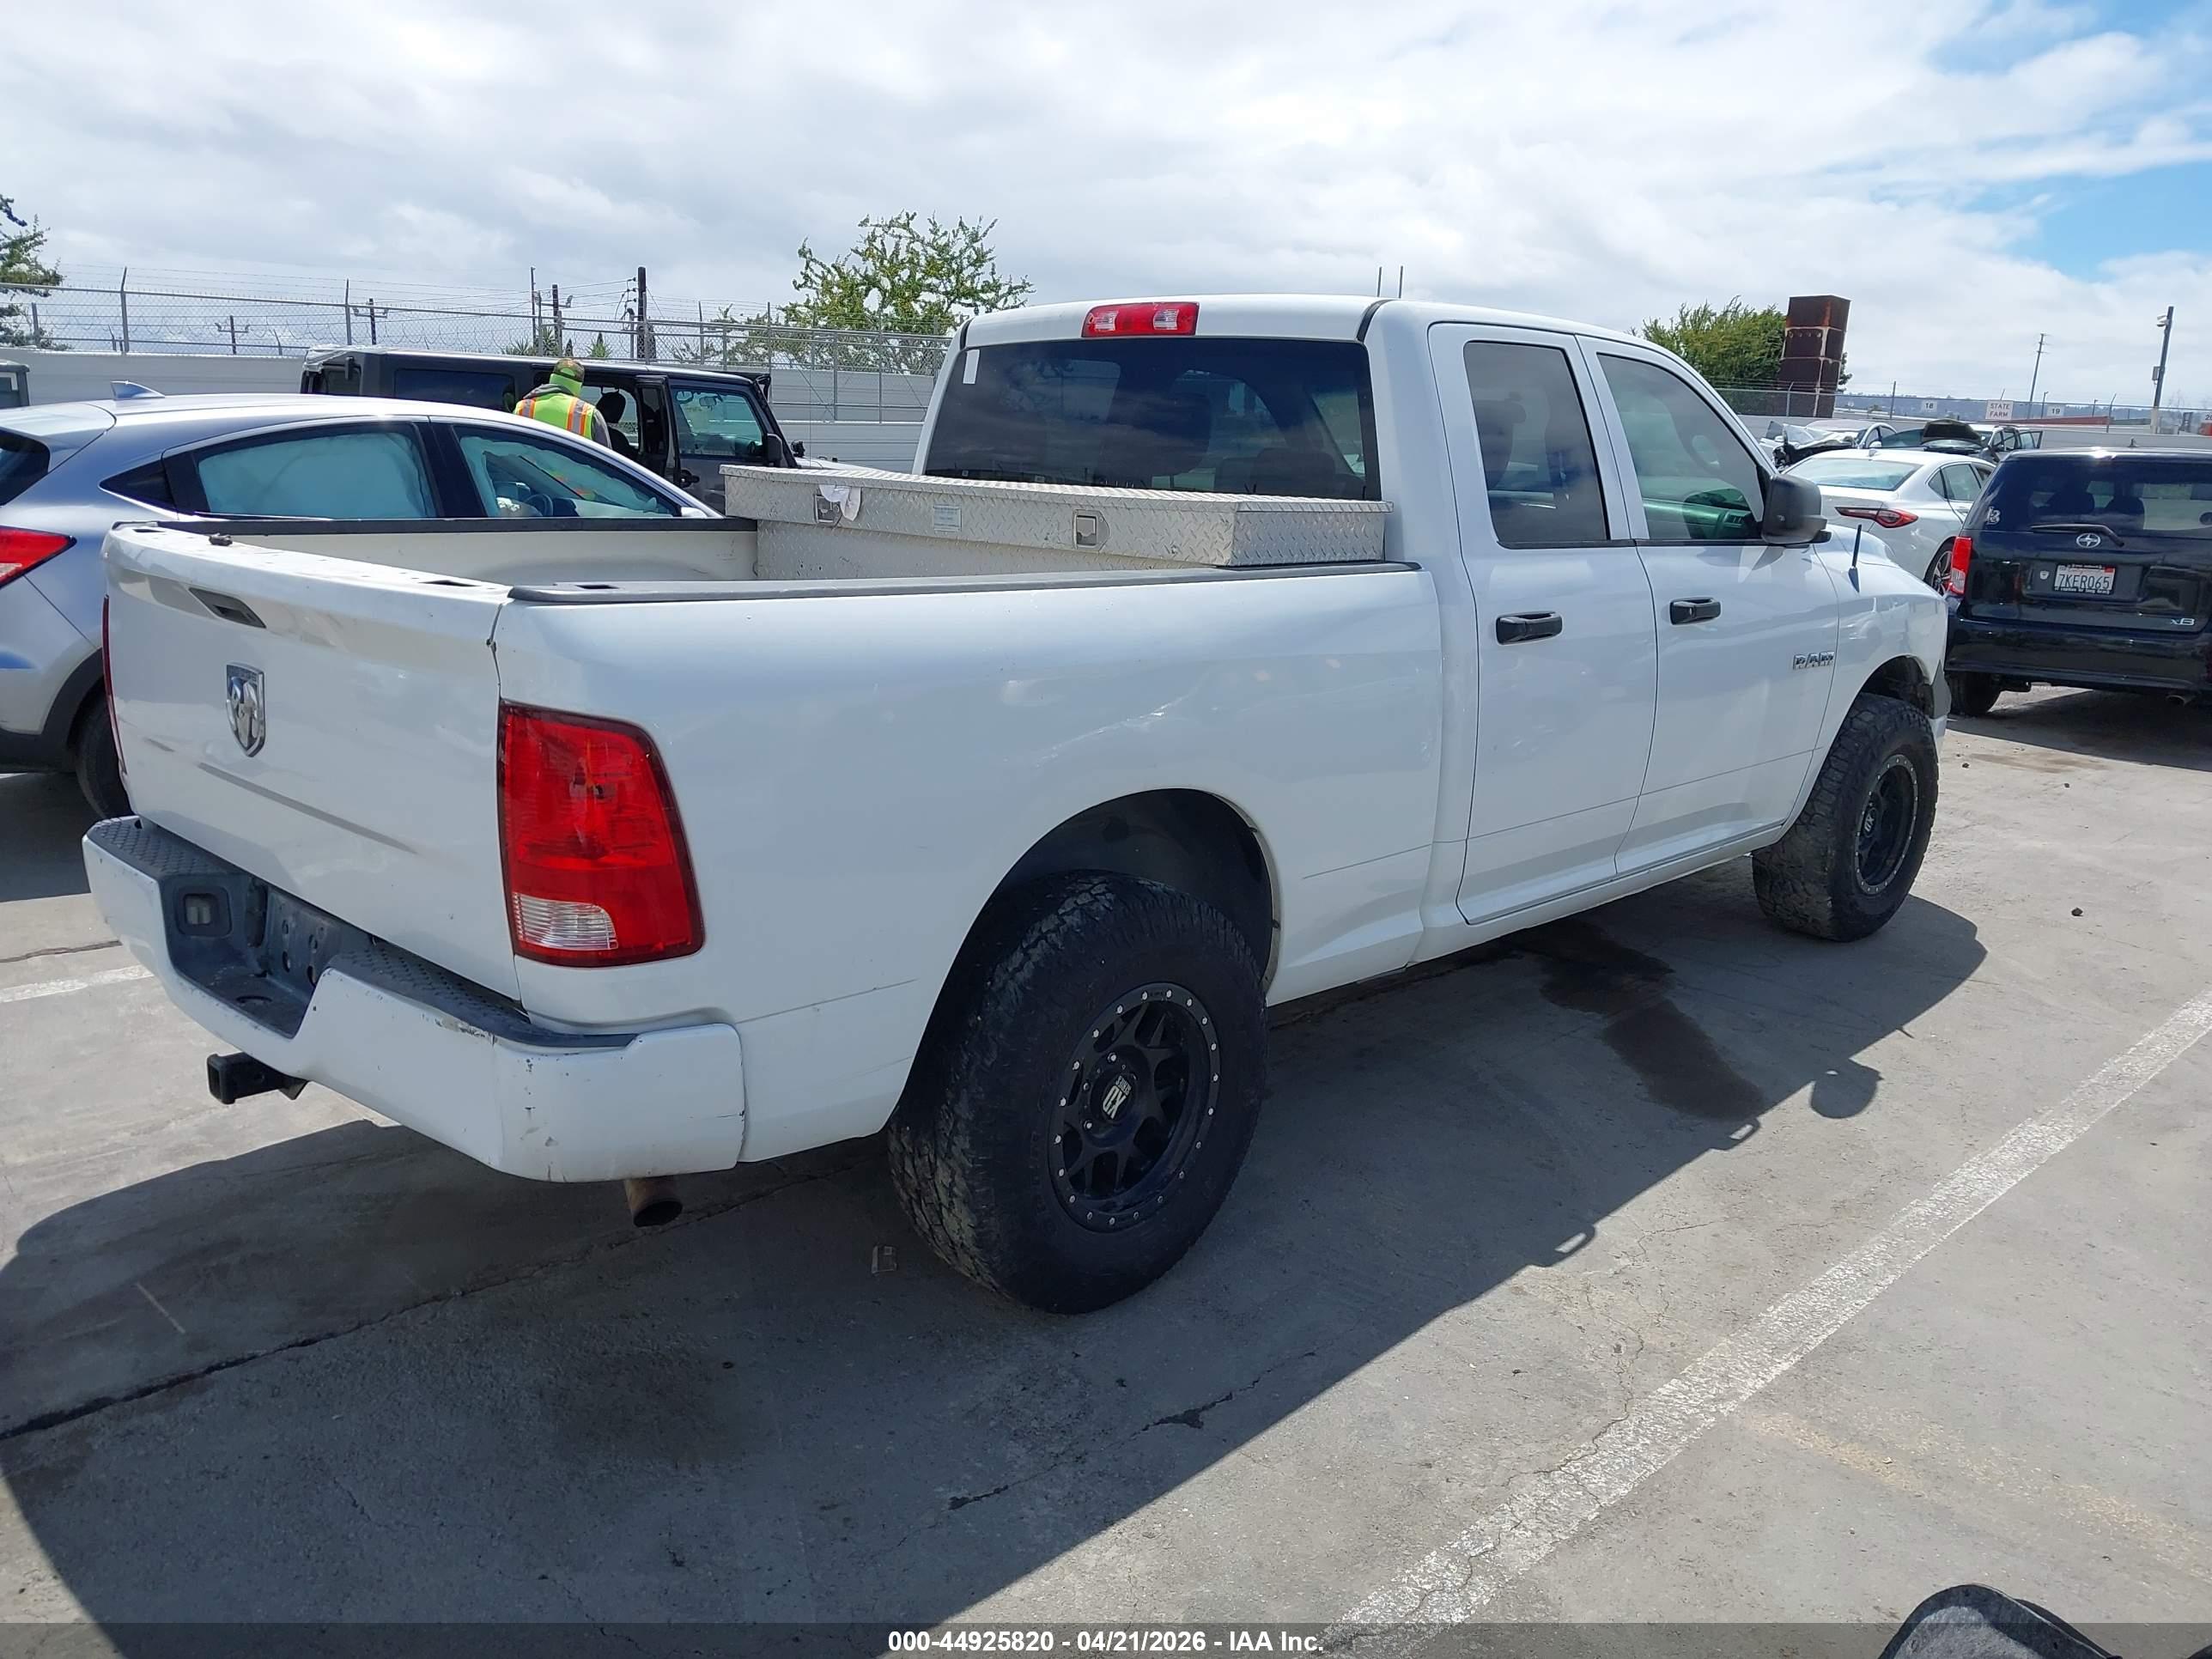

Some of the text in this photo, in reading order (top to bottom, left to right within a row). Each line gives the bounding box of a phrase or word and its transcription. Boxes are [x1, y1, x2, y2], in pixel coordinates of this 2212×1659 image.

[2058, 574, 2111, 590] 7KER065
[2170, 617, 2196, 626] xB
[1792, 650, 1835, 671] RAM
[1103, 1085, 1127, 1120] XD
